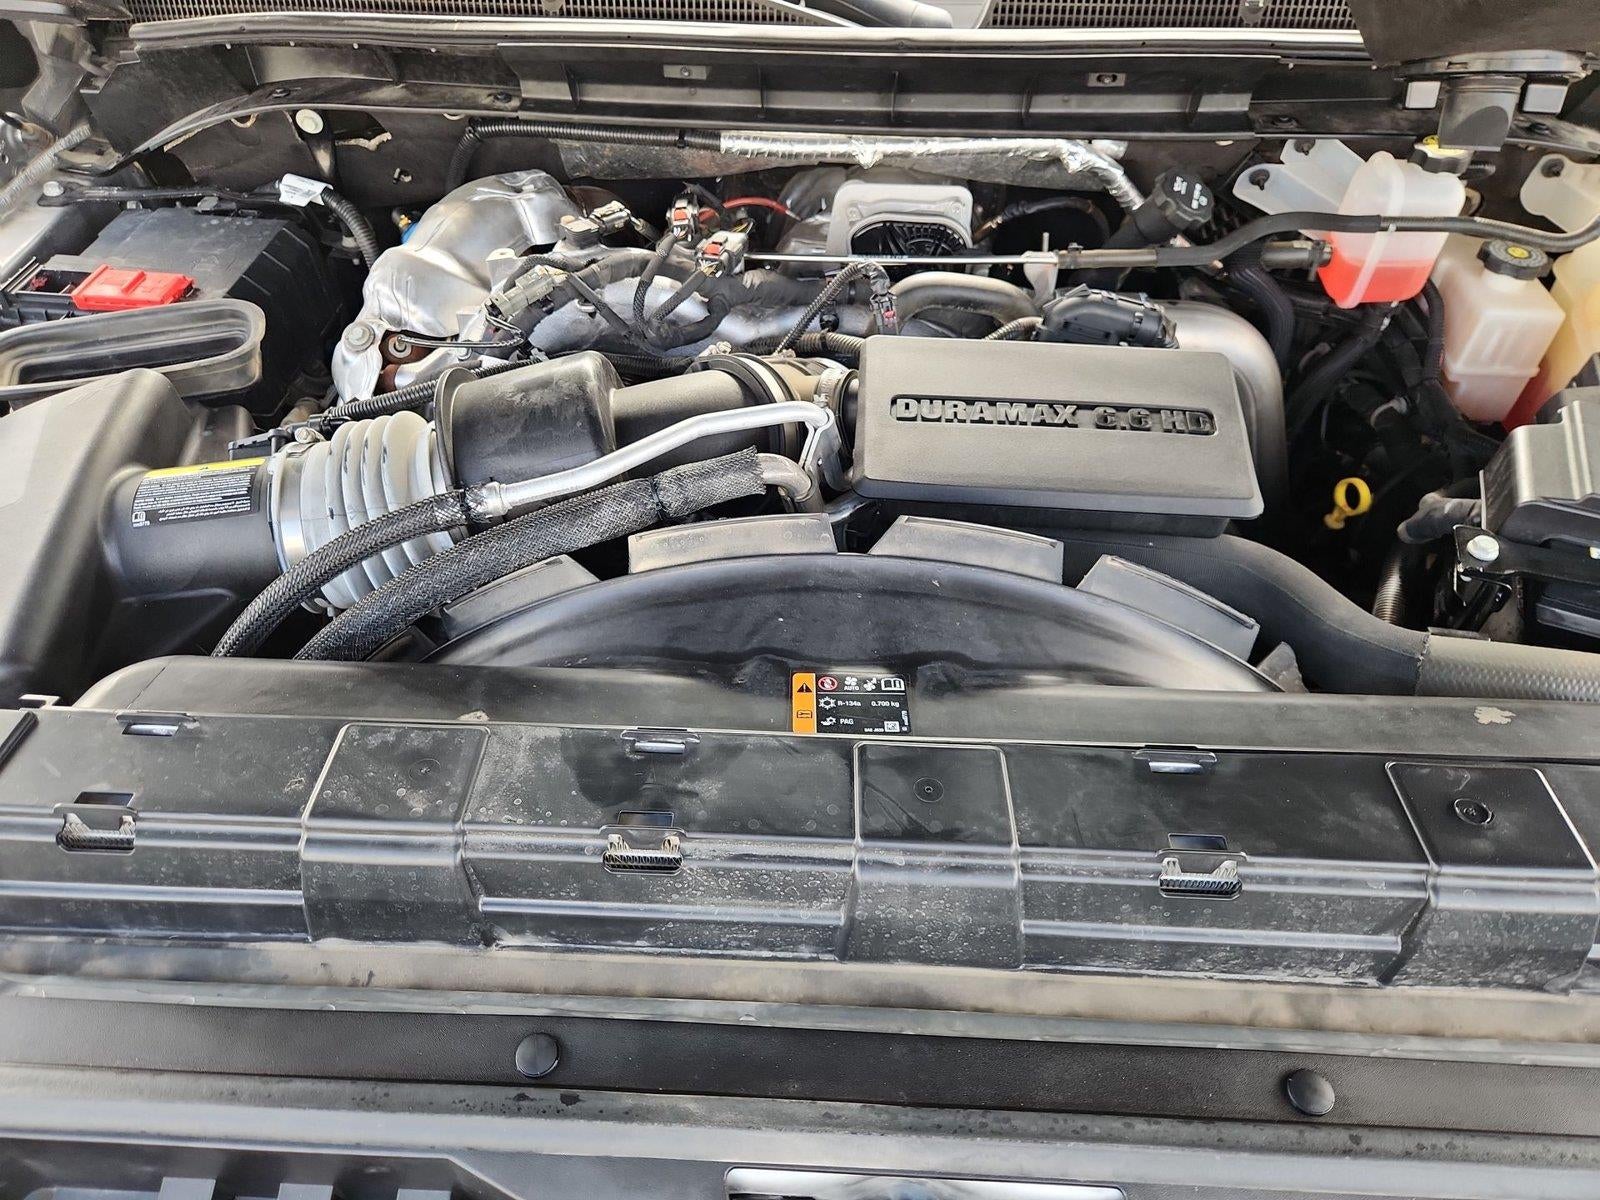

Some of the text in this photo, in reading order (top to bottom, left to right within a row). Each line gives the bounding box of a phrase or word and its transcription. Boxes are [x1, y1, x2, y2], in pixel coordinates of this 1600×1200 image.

[895, 397, 1217, 436] DURAMAX 6.6 HD
